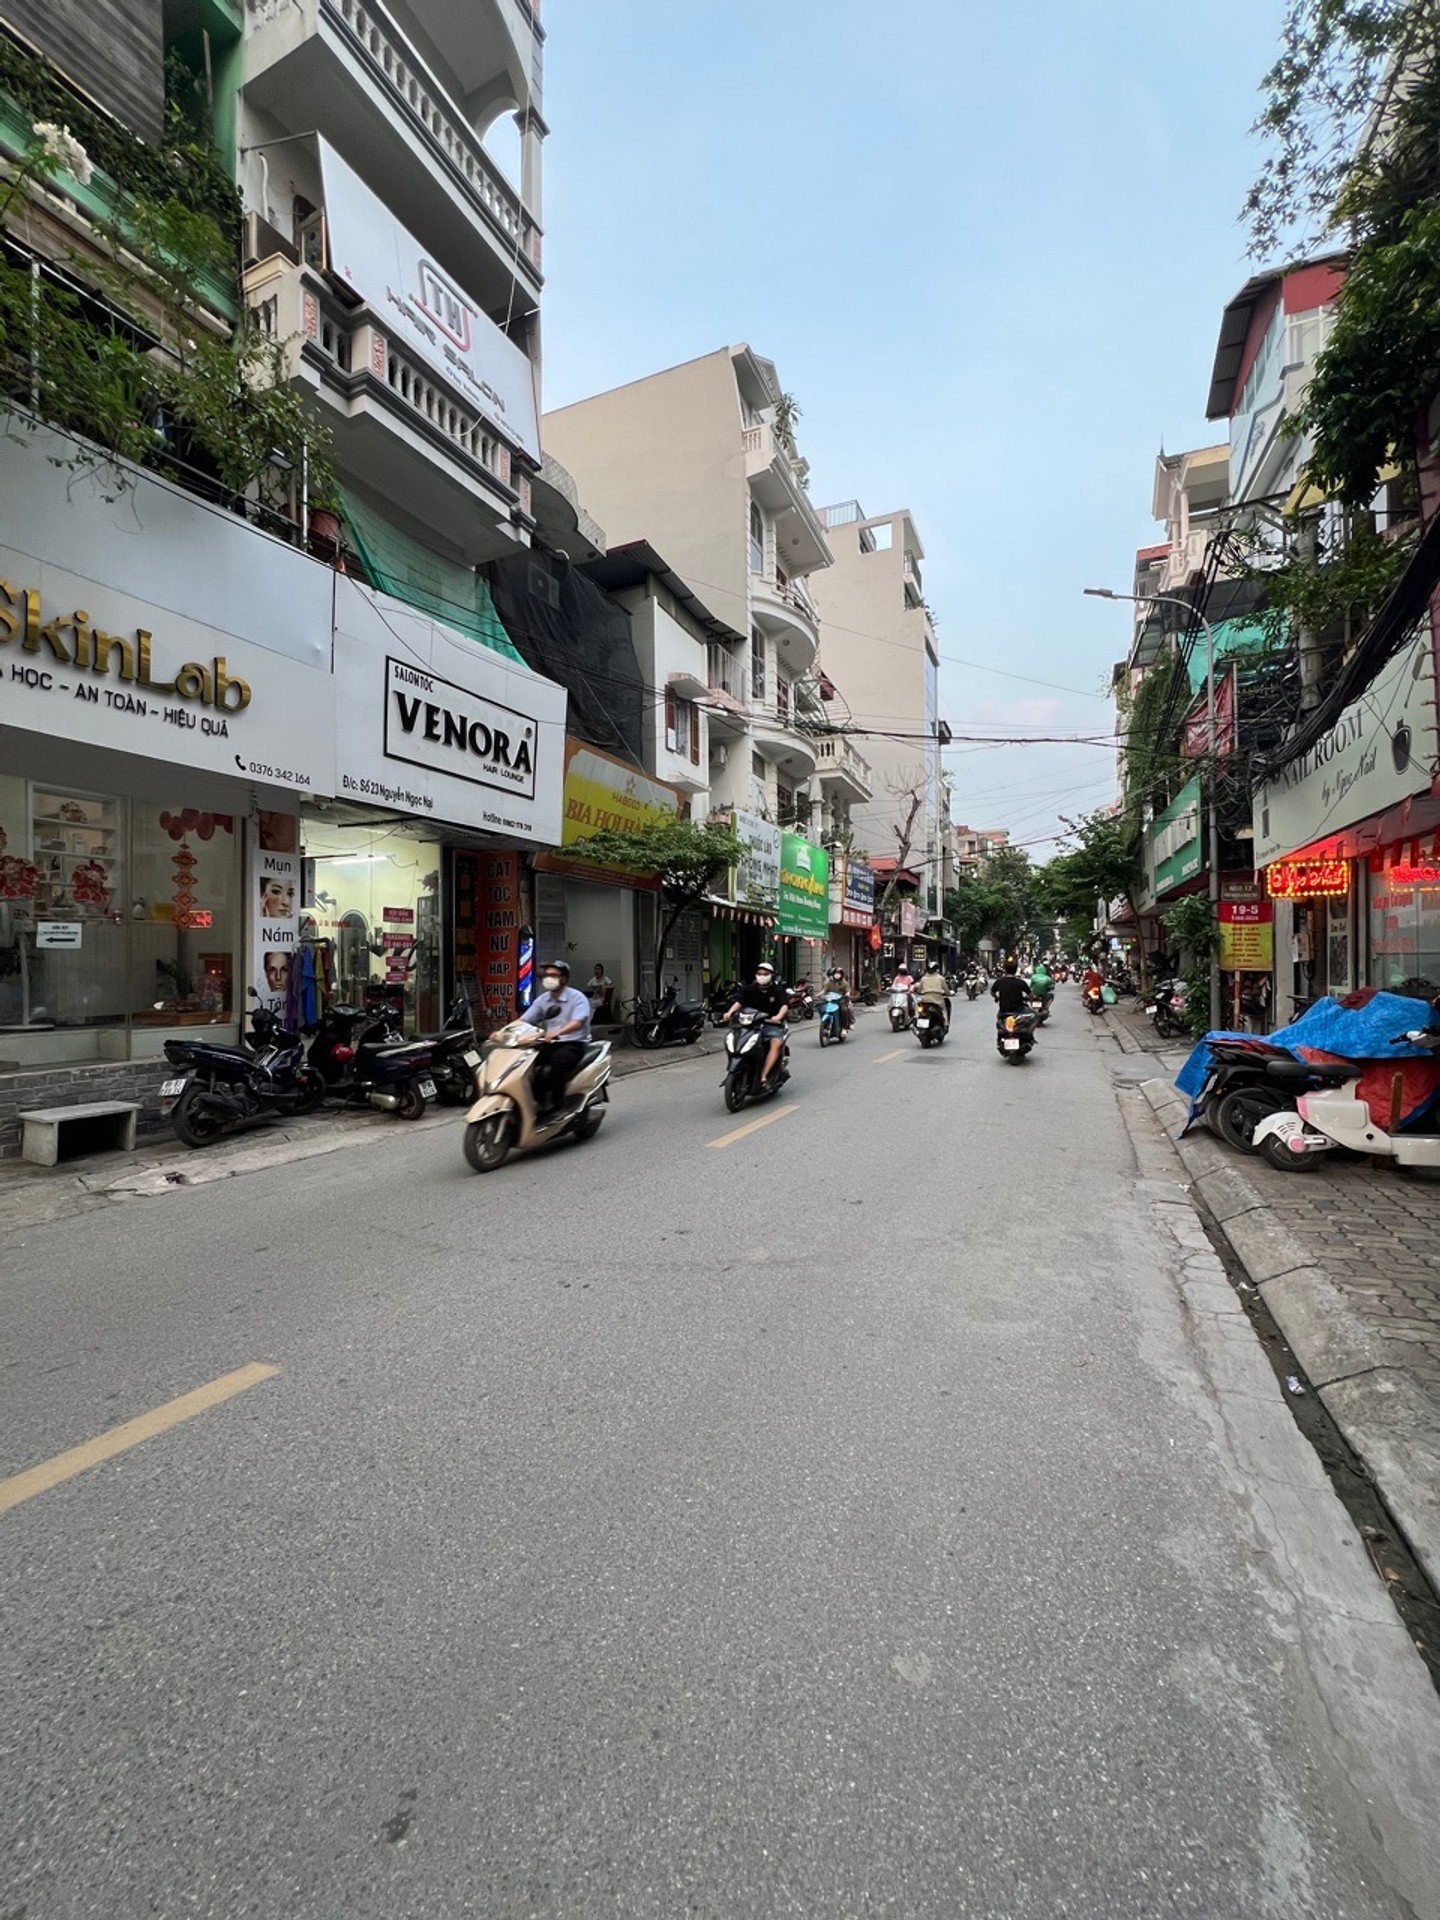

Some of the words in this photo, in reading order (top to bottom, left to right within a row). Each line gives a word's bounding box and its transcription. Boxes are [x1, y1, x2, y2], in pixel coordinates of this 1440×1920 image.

[443, 343, 505, 413] SALON
[11, 664, 53, 690] HỌC
[74, 683, 99, 703] AN
[104, 690, 147, 717] TOÀN
[163, 706, 197, 729] HIỆU
[201, 716, 229, 738] QUẢ
[1314, 707, 1363, 772] ROOM
[249, 761, 273, 777] 0376
[274, 767, 293, 782] 342
[295, 772, 311, 786] 164
[483, 763, 498, 775] HAIR
[500, 769, 525, 785] LOUNGE
[371, 781, 380, 794] 23
[565, 797, 592, 828] BIA
[264, 857, 292, 875] Mụn
[484, 910, 514, 927] NAM
[1231, 905, 1259, 915] 19-5
[262, 927, 294, 944] Nám
